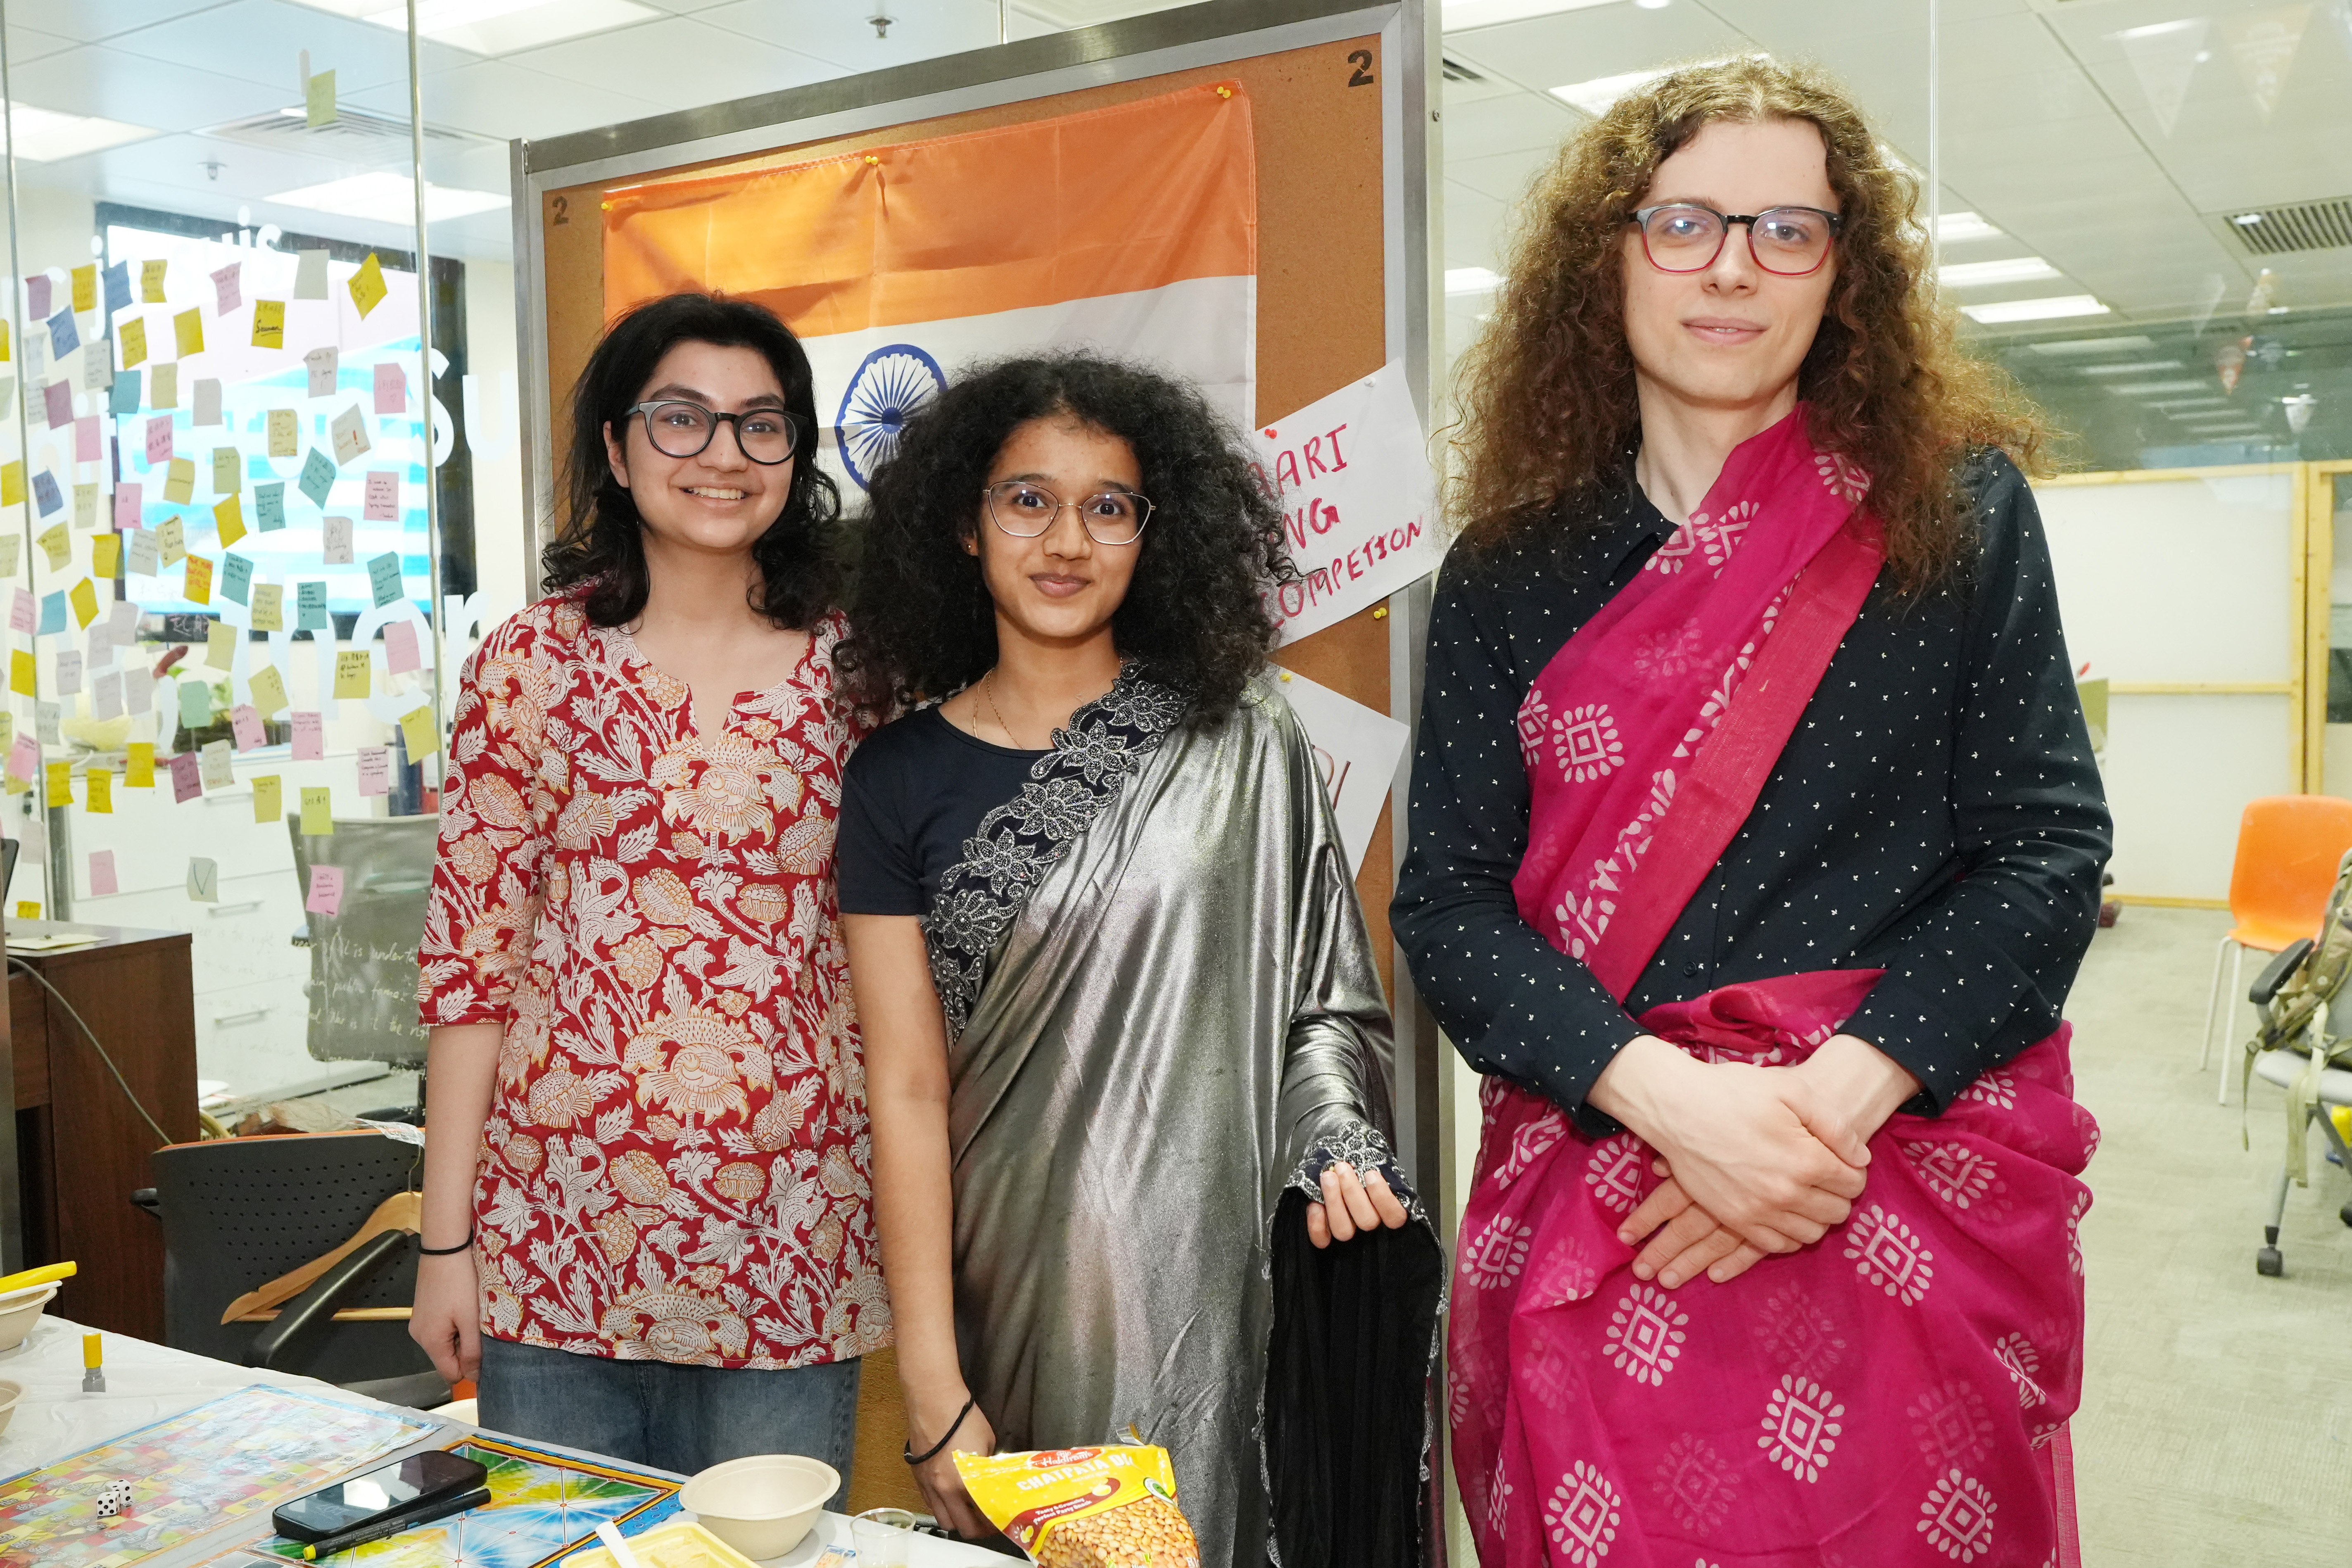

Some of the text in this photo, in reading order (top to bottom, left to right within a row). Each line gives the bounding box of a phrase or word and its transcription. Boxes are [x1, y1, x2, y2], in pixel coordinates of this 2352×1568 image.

[1348, 50, 1374, 87] 2
[552, 196, 569, 226] 2
[1268, 498, 1340, 554] NG
[1016, 1459, 1109, 1490] CHATPATA
